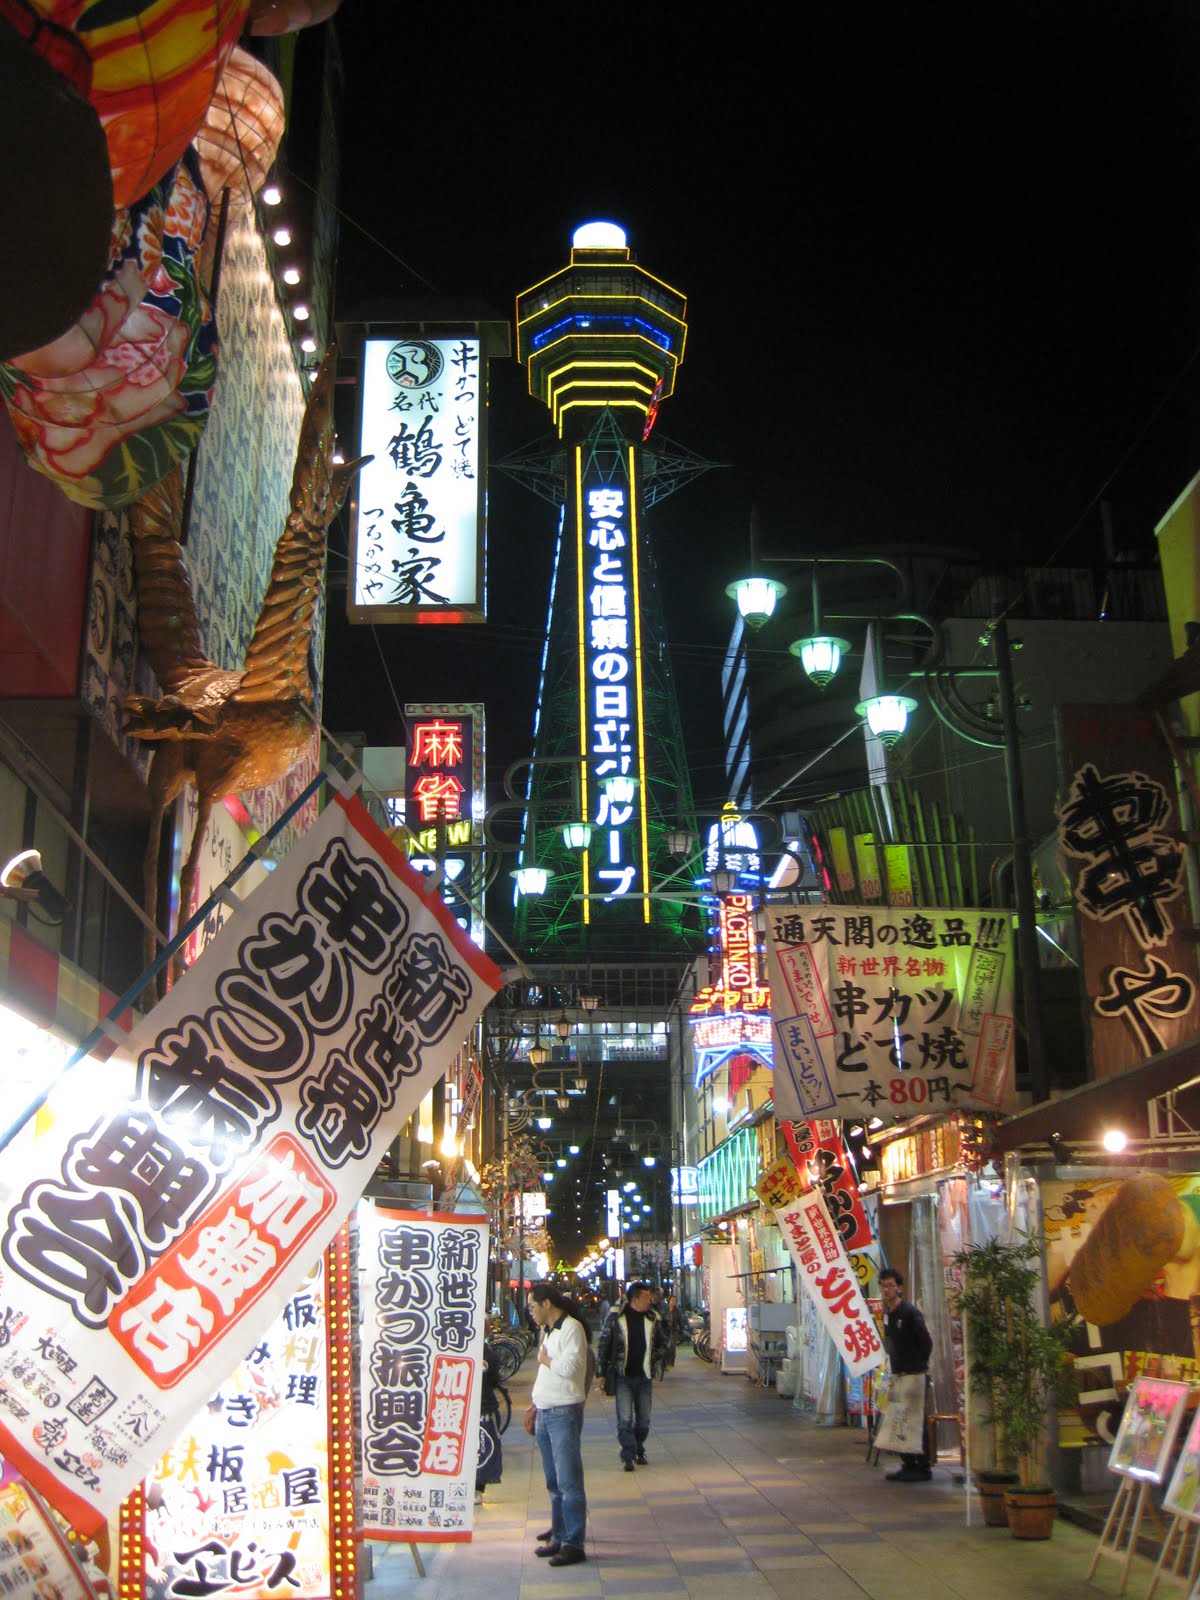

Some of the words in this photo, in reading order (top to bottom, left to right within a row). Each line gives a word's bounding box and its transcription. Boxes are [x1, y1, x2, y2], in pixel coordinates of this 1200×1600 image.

[387, 391, 443, 413] 名代
[363, 509, 384, 599] つるかめや
[386, 415, 451, 604] 鶴亀家
[587, 487, 635, 902] 安心と信頼の日立グループ
[410, 719, 465, 821] 麻雀
[726, 895, 751, 987] PACHINKO
[837, 955, 945, 978] 新世界名物
[298, 932, 471, 1169] 新世界
[833, 981, 957, 1029] 串カツ
[836, 1030, 969, 1074] どて焼
[2, 837, 408, 1328] 串かつ振興会
[121, 1150, 326, 1376] 加盟店
[784, 1212, 822, 1274] やまと屋の
[808, 1205, 838, 1262] 新世界名物
[433, 1229, 480, 1352] 新世界
[815, 1267, 881, 1364] どて焼
[365, 1227, 434, 1476] 串かつ振興会
[425, 1360, 470, 1473] 加盟店
[54, 1448, 100, 1490] エビス
[171, 1541, 301, 1597] エビス
